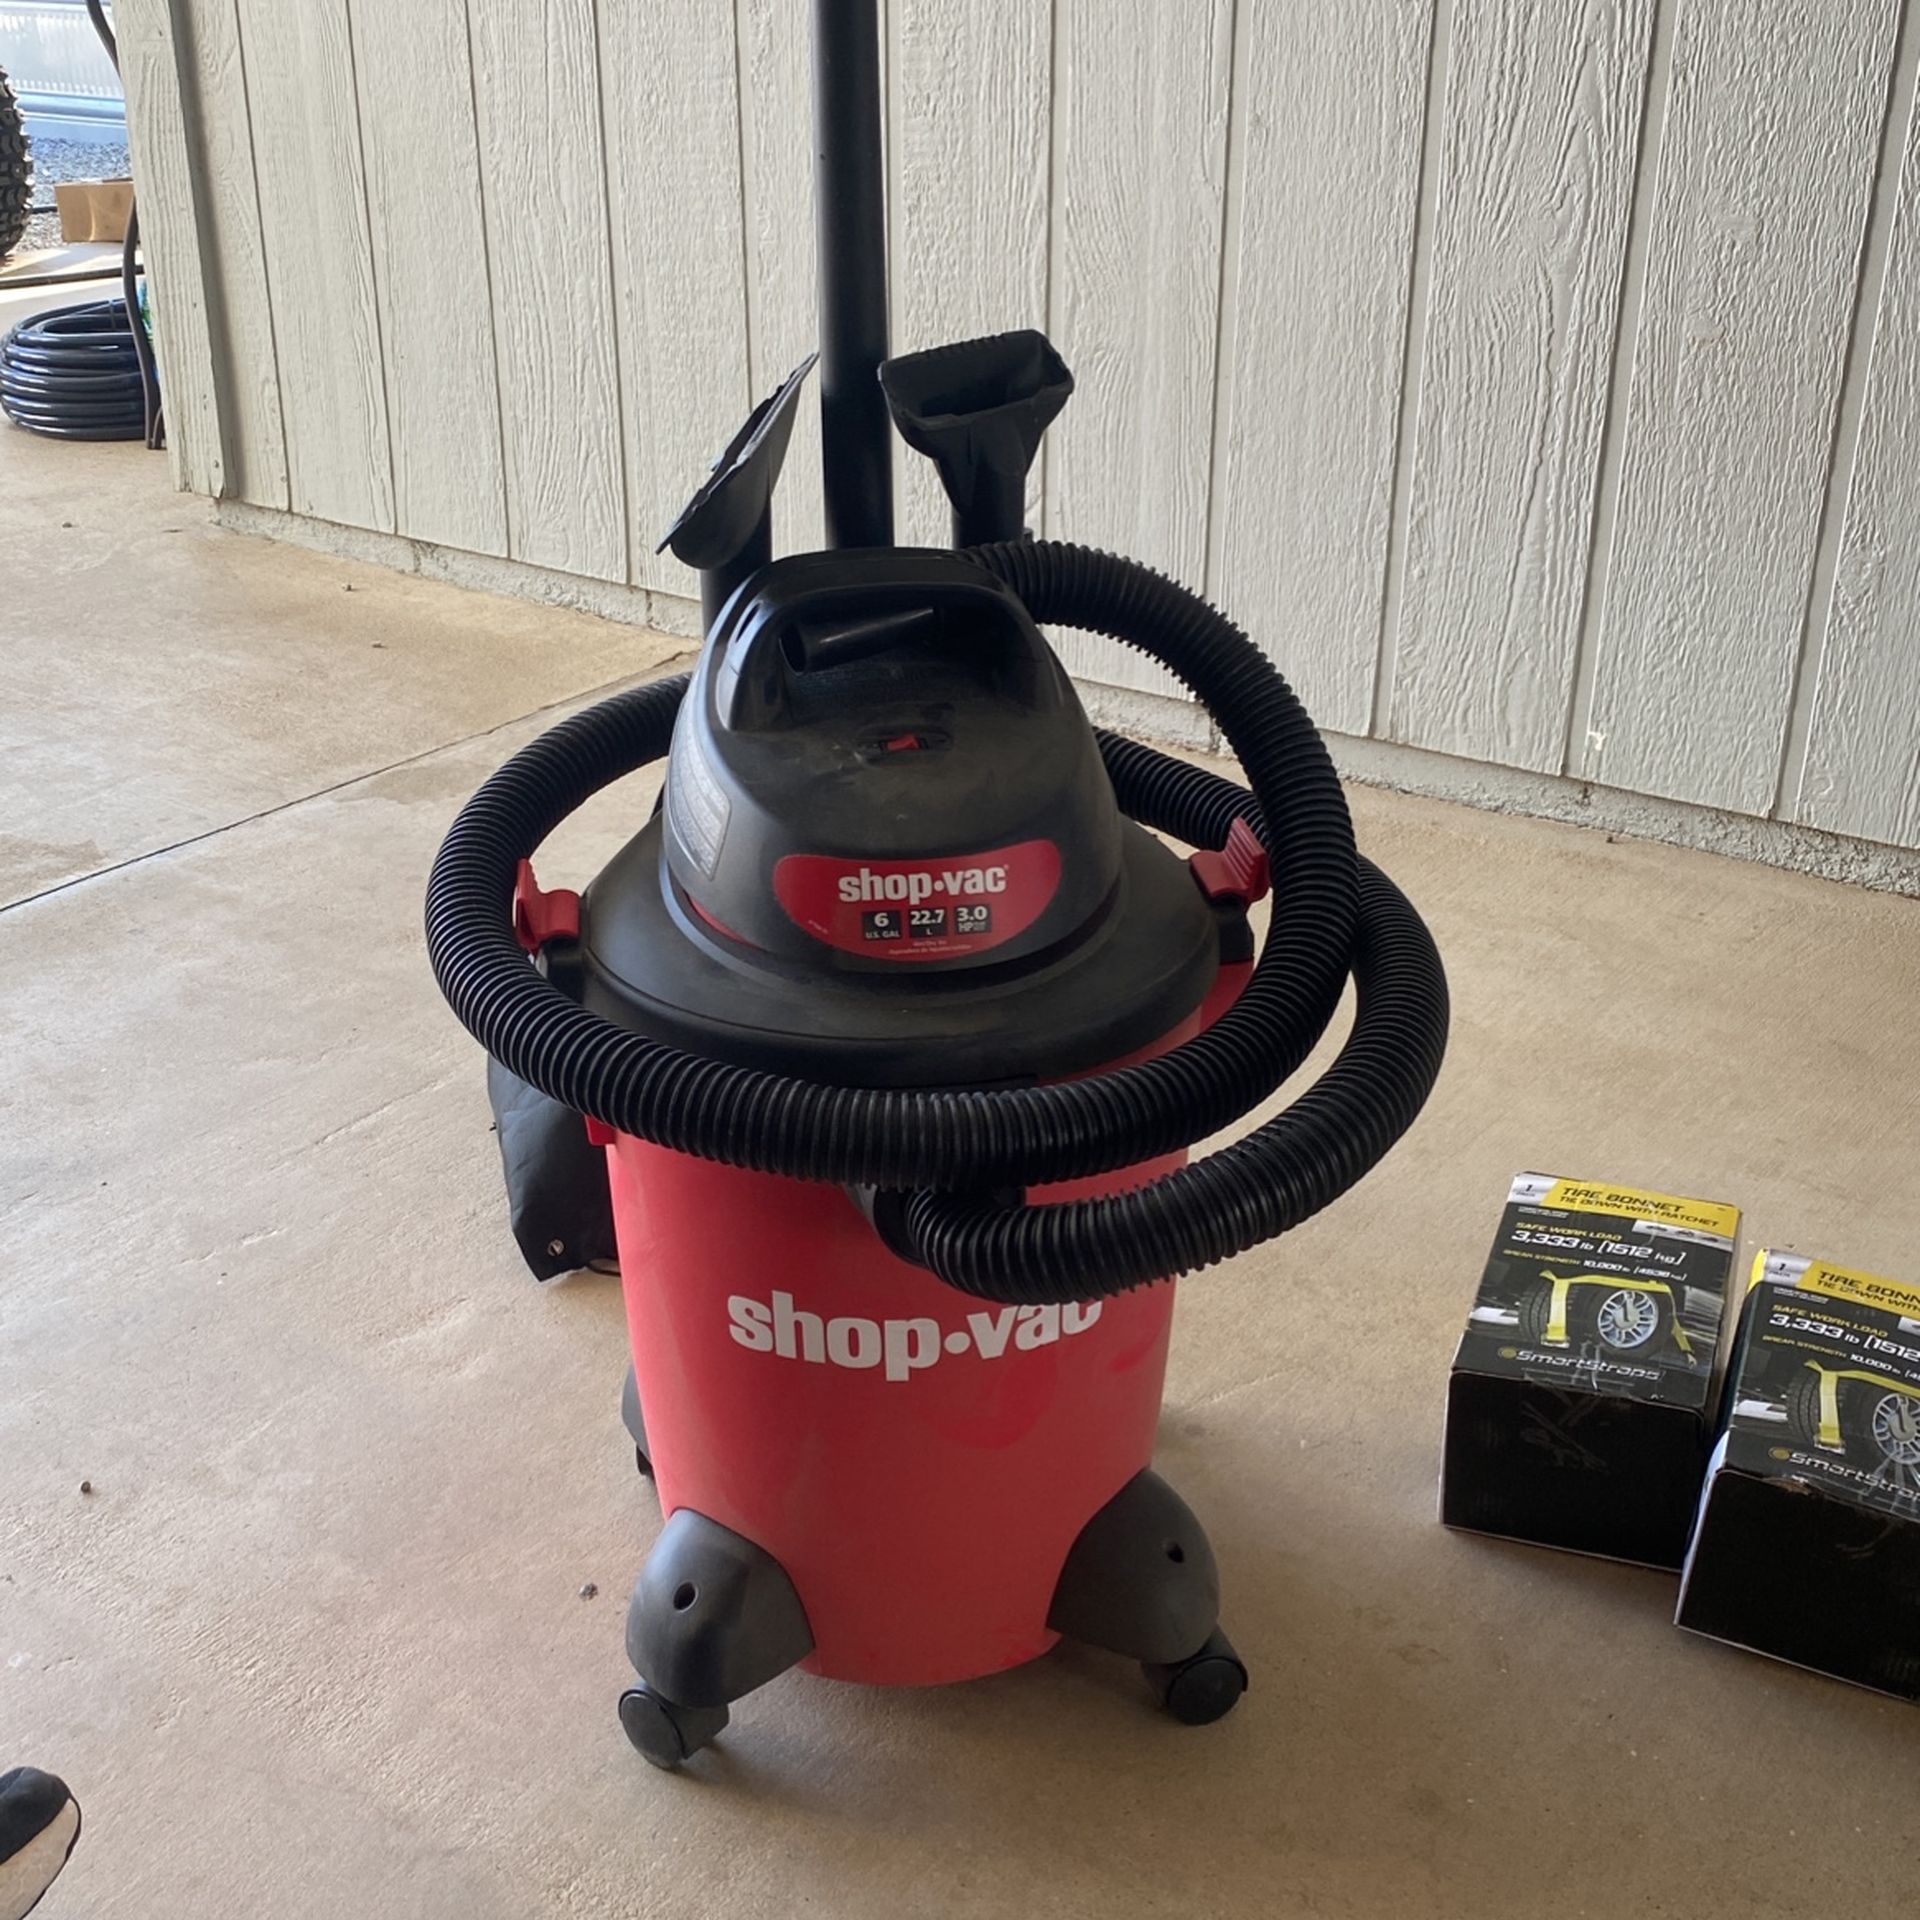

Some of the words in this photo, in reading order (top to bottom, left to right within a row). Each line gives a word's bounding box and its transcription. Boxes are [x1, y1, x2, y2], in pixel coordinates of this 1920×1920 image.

[874, 912, 889, 927] 6
[910, 909, 945, 925] 22.7
[957, 906, 988, 921] 3.0
[1562, 1187, 1602, 1199] TIRE
[1606, 1193, 1685, 1212] BONNET
[1580, 1198, 1622, 1210] DOWN
[1660, 1209, 1719, 1227] RATCHET
[1511, 1230, 1581, 1248] 3,333
[1515, 1222, 1548, 1231] SAFE
[1549, 1226, 1587, 1237] WORK
[1589, 1231, 1622, 1241] LOAD
[1820, 1271, 1862, 1287] TIRE
[1817, 1280, 1836, 1289] TIE
[1840, 1285, 1884, 1302] DOWN
[1769, 1313, 1844, 1339] 3,333
[1844, 1333, 1860, 1344] lb
[1772, 1304, 1807, 1316] SAFE
[1809, 1311, 1850, 1328] WORK
[1853, 1323, 1889, 1338] LOAD
